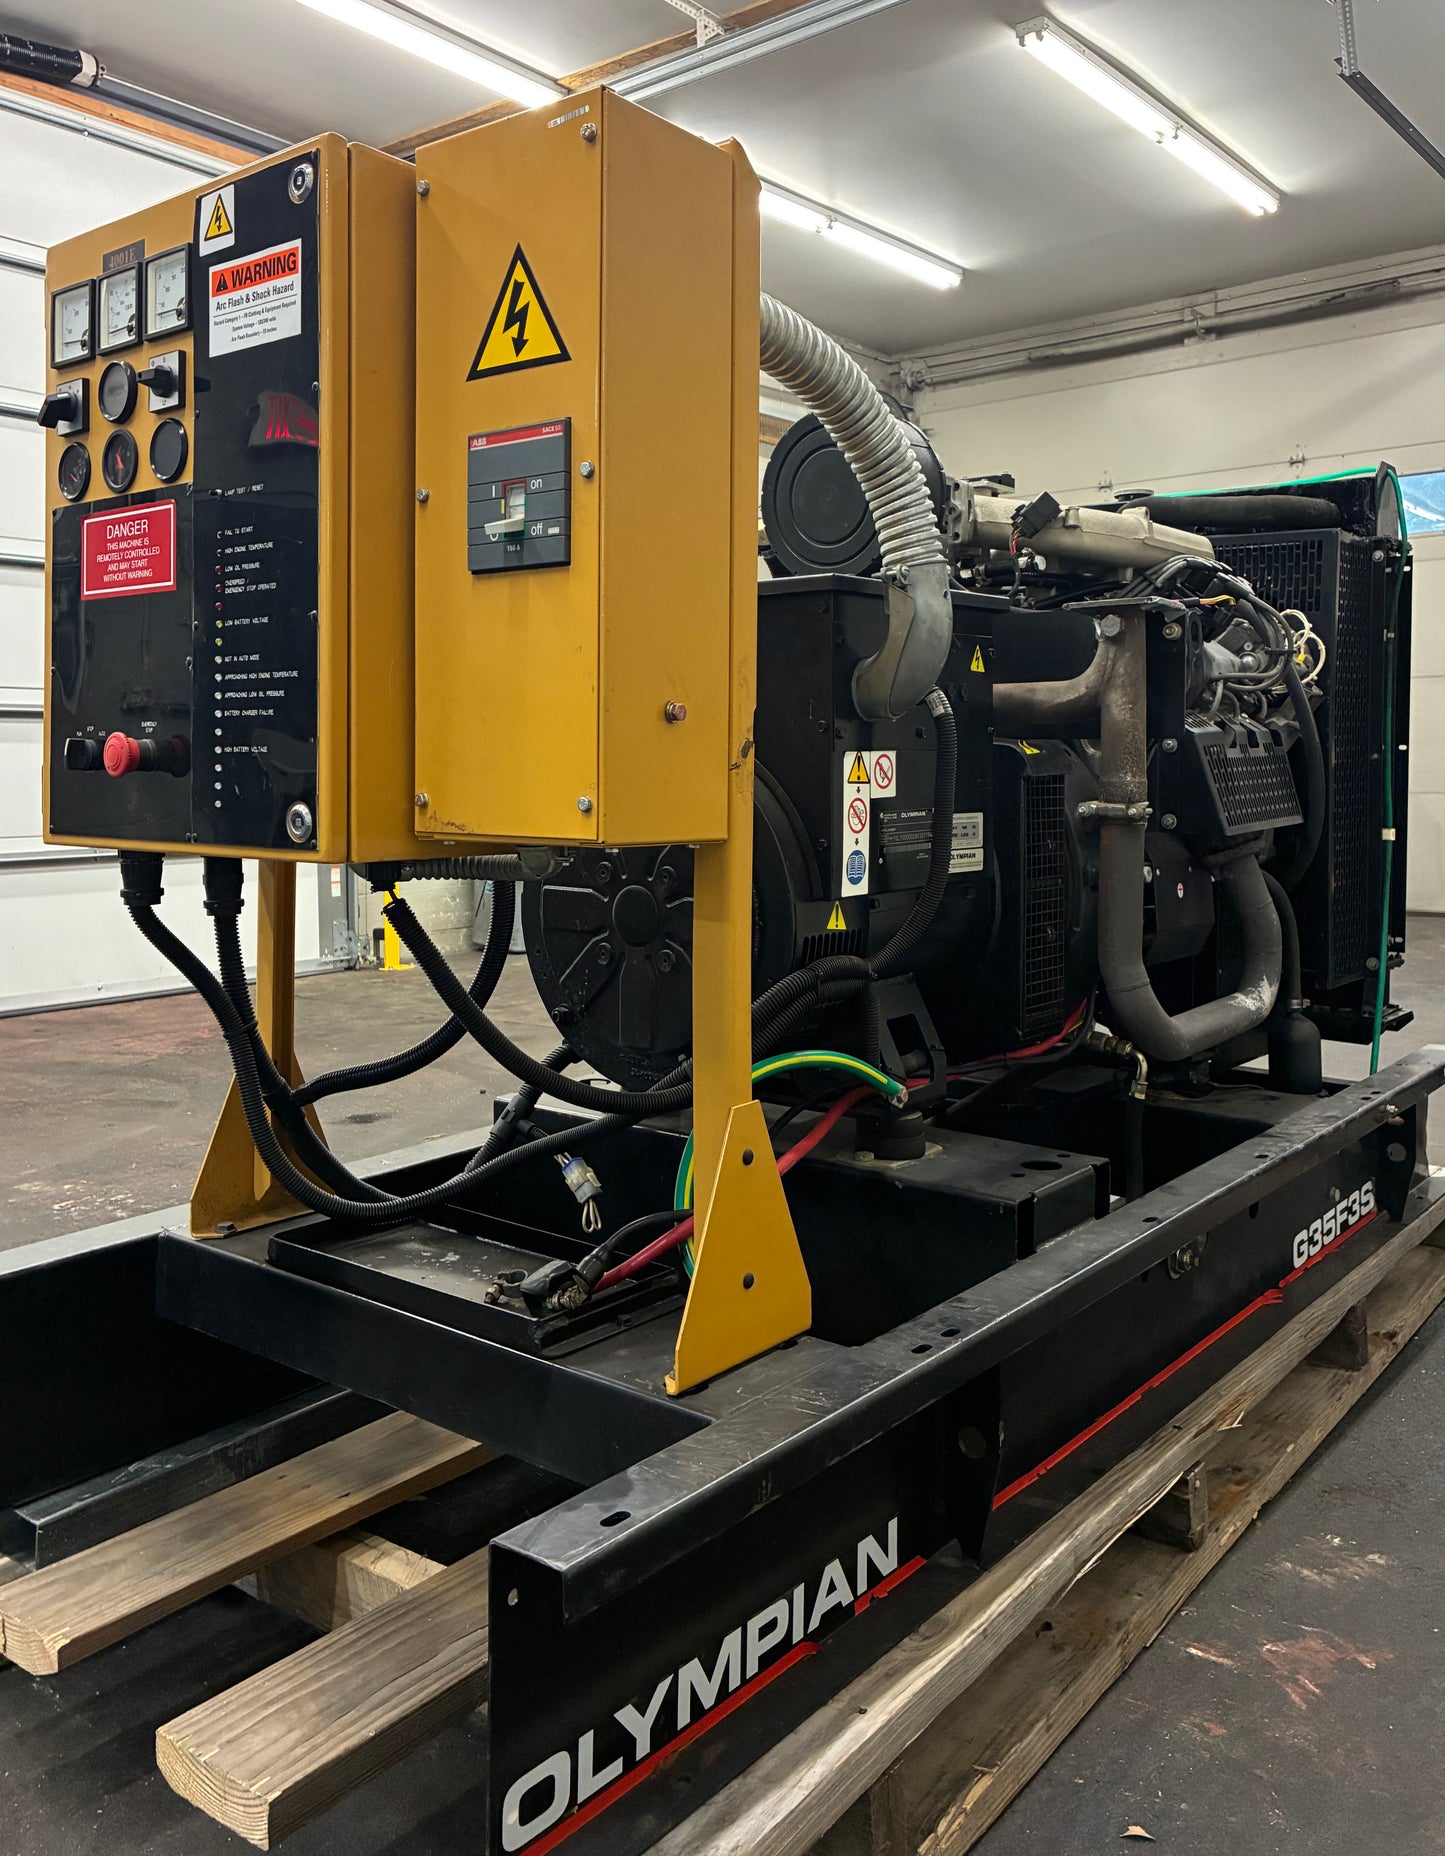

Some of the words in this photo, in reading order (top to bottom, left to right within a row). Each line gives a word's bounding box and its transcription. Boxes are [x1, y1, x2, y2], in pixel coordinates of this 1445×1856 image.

[231, 252, 296, 288] WARNING
[216, 301, 226, 312] Arc
[228, 296, 244, 308] Flash
[246, 294, 250, 304] &
[252, 287, 270, 302] Shock
[272, 280, 294, 296] Hazard
[542, 426, 554, 434] SACE
[472, 437, 486, 446] ABB
[530, 478, 542, 490] on
[106, 520, 148, 539] DANGER
[531, 522, 544, 536] off
[107, 542, 118, 551] THIS
[120, 538, 143, 549] MACHINE
[144, 537, 150, 546] IS
[96, 552, 124, 562] REMOTELY
[124, 546, 160, 559] CONTROLLED
[108, 563, 118, 572] AND
[120, 561, 130, 570] MAY
[132, 558, 148, 568] START
[103, 572, 126, 582] WITHOUT
[128, 569, 152, 579] WARNING
[502, 1516, 898, 1852] OLYMPIAN
